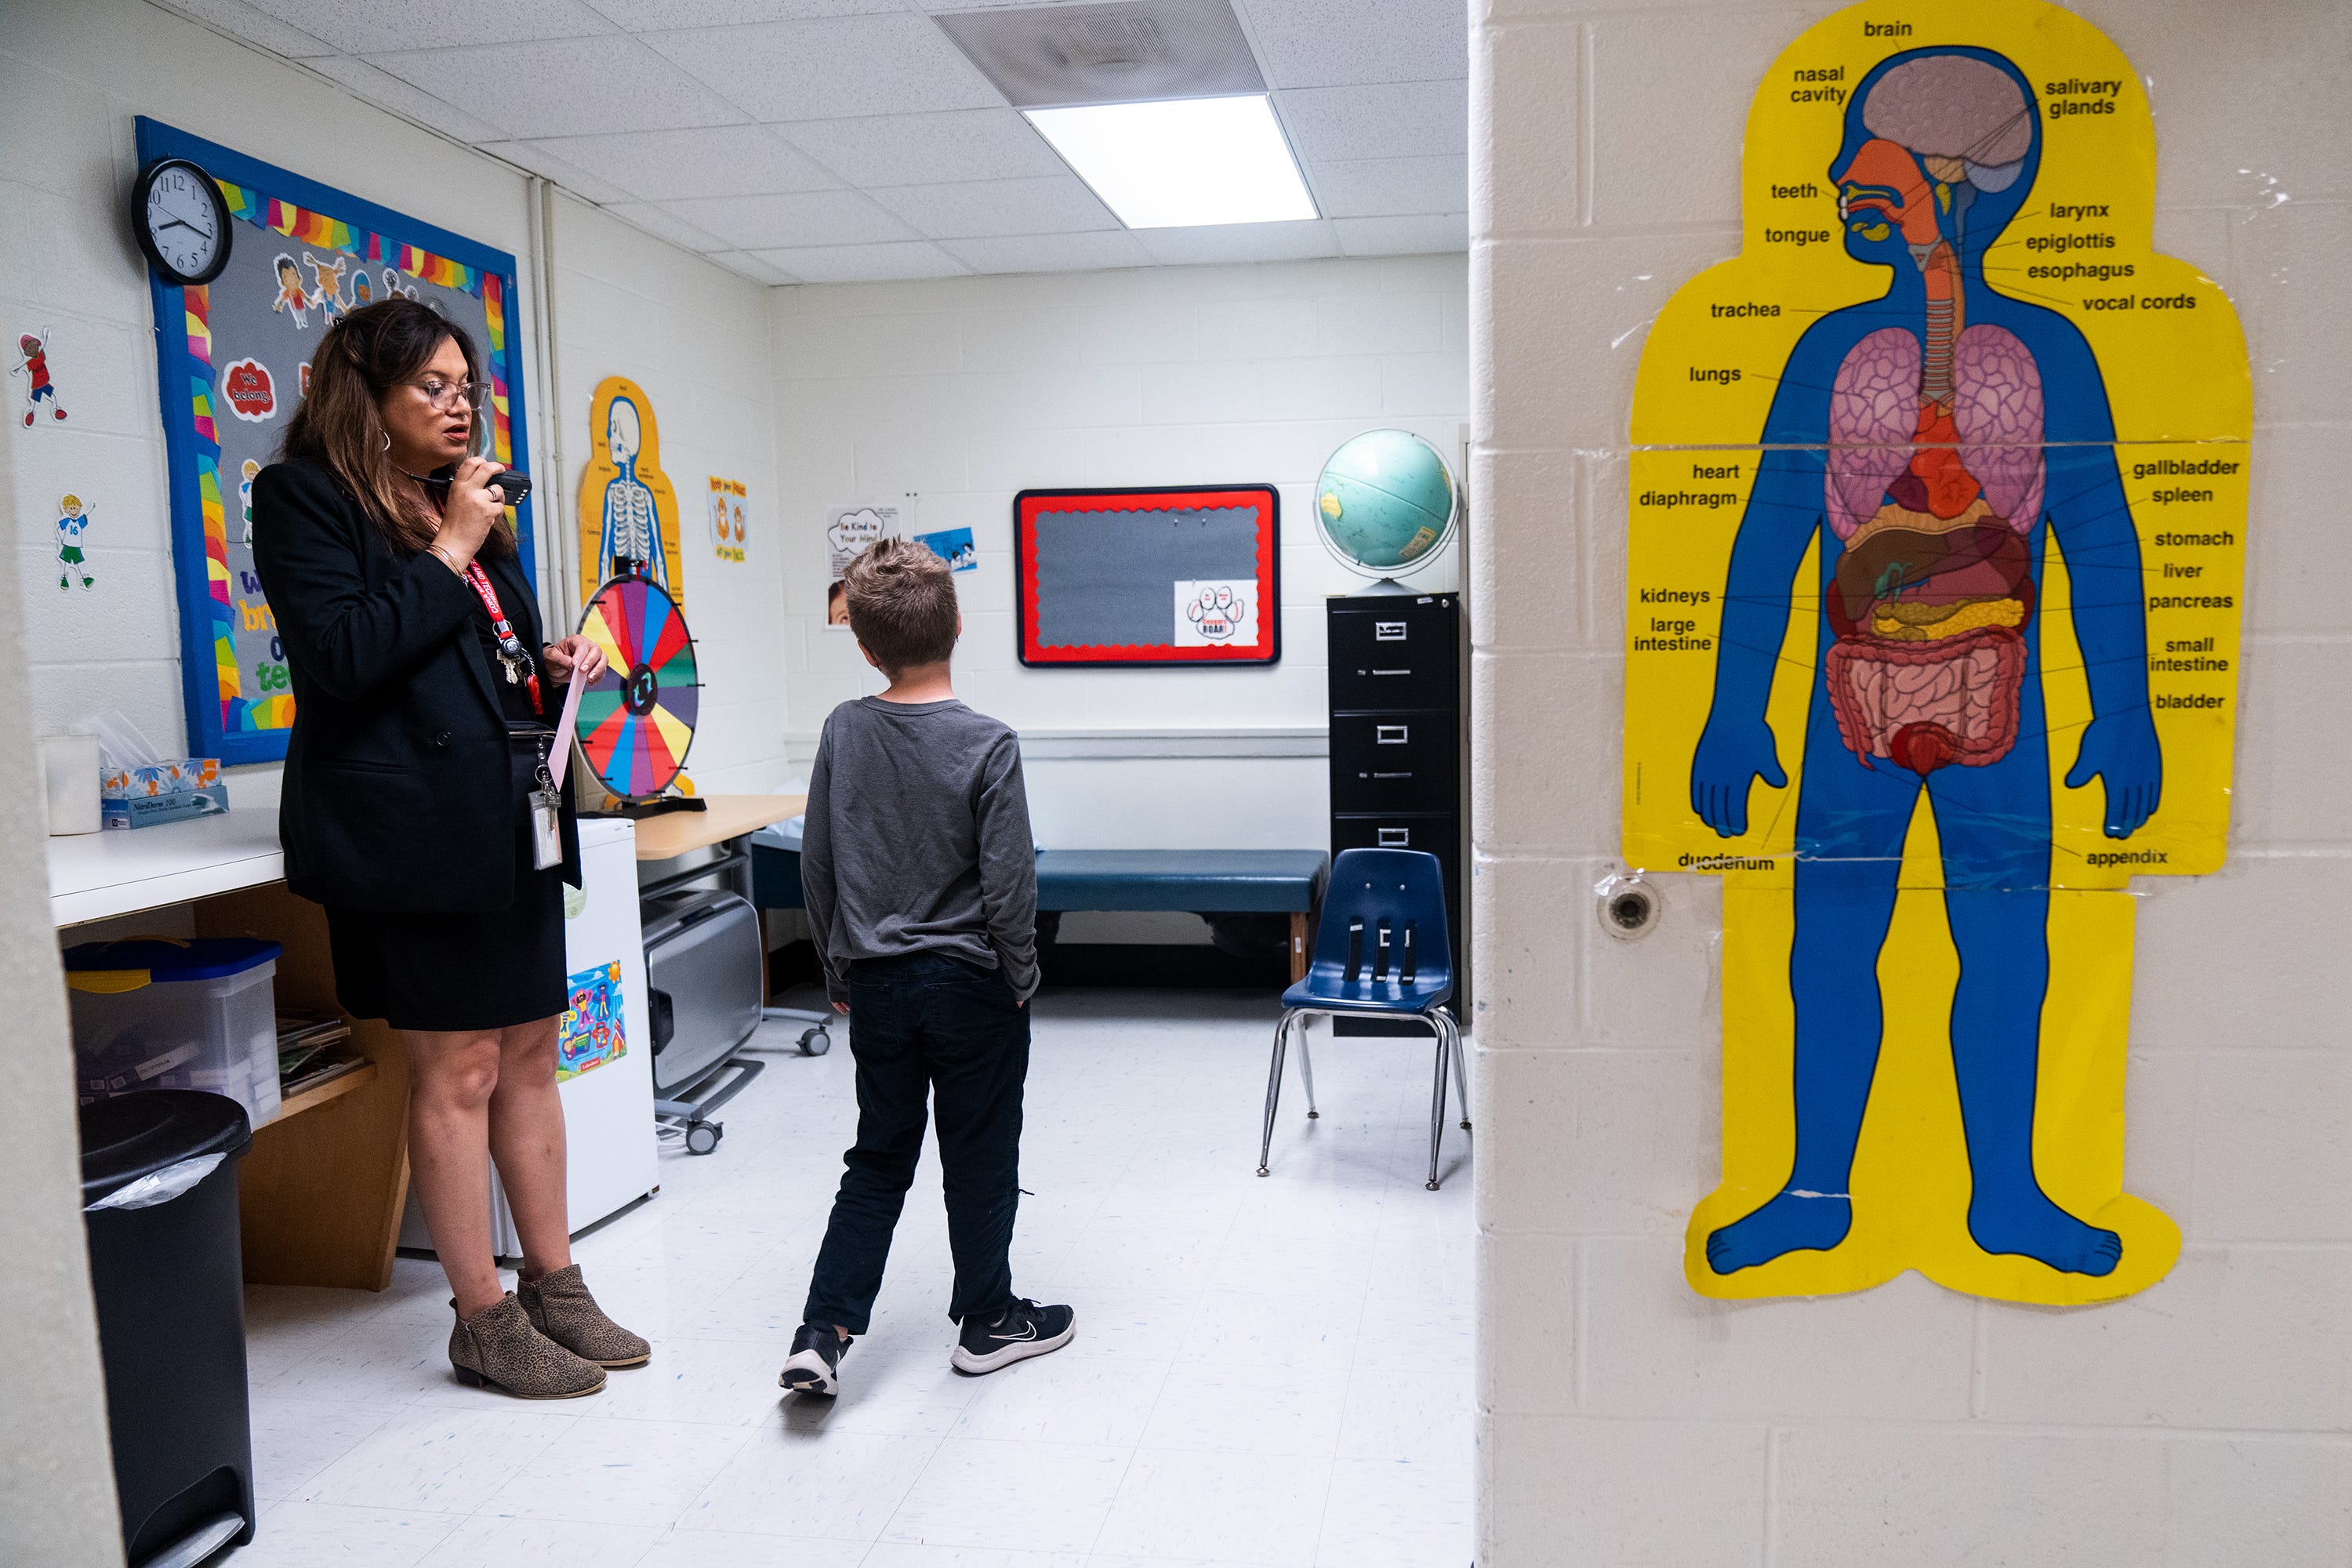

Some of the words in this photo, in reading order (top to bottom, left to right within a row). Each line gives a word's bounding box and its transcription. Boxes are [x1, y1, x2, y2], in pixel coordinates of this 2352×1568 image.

[1864, 21, 1912, 37] brain
[1795, 66, 1844, 82] nasal
[1791, 86, 1846, 105] cavity
[2045, 78, 2122, 97] salivary
[2049, 99, 2114, 120] glands
[160, 176, 169, 193] 11
[172, 175, 185, 191] 12
[1771, 183, 1817, 198] teeth
[149, 189, 161, 205] 10
[192, 185, 196, 200] 1
[201, 202, 208, 218] 2
[2050, 203, 2109, 222] larynx
[1766, 228, 1830, 246] tongue
[2026, 234, 2115, 253] epiglottis
[162, 245, 169, 260] 7
[201, 241, 208, 255] 4
[177, 254, 184, 269] 6
[191, 252, 198, 267] 5
[2027, 263, 2134, 281] esophagus
[2083, 295, 2134, 310] vocal
[2141, 293, 2196, 310] cords
[1711, 302, 1780, 318] trachea
[241, 373, 257, 385] We
[1690, 367, 1741, 385] lungs
[232, 389, 270, 403] belong.
[1693, 464, 1739, 479] heart
[2133, 459, 2239, 480] gallbladder
[1639, 491, 1737, 510] diaphragm
[2153, 488, 2212, 504] spleen
[70, 525, 78, 535] 16
[851, 522, 867, 531] Kind
[860, 534, 877, 543] Mind
[2155, 531, 2234, 546] stomach
[473, 566, 486, 580] AND
[2165, 564, 2202, 578] liver
[466, 574, 485, 593] KELLY
[484, 593, 499, 614] CORA
[1641, 589, 1710, 606] kidneys
[2150, 597, 2233, 612] pancreas
[1651, 618, 1695, 634] large
[1635, 637, 1711, 651] intestine
[2166, 637, 2213, 652] small
[2151, 658, 2228, 672] intestine
[2156, 694, 2224, 709] bladder
[1678, 852, 1774, 870] duodenum
[2087, 852, 2167, 868] appendix
